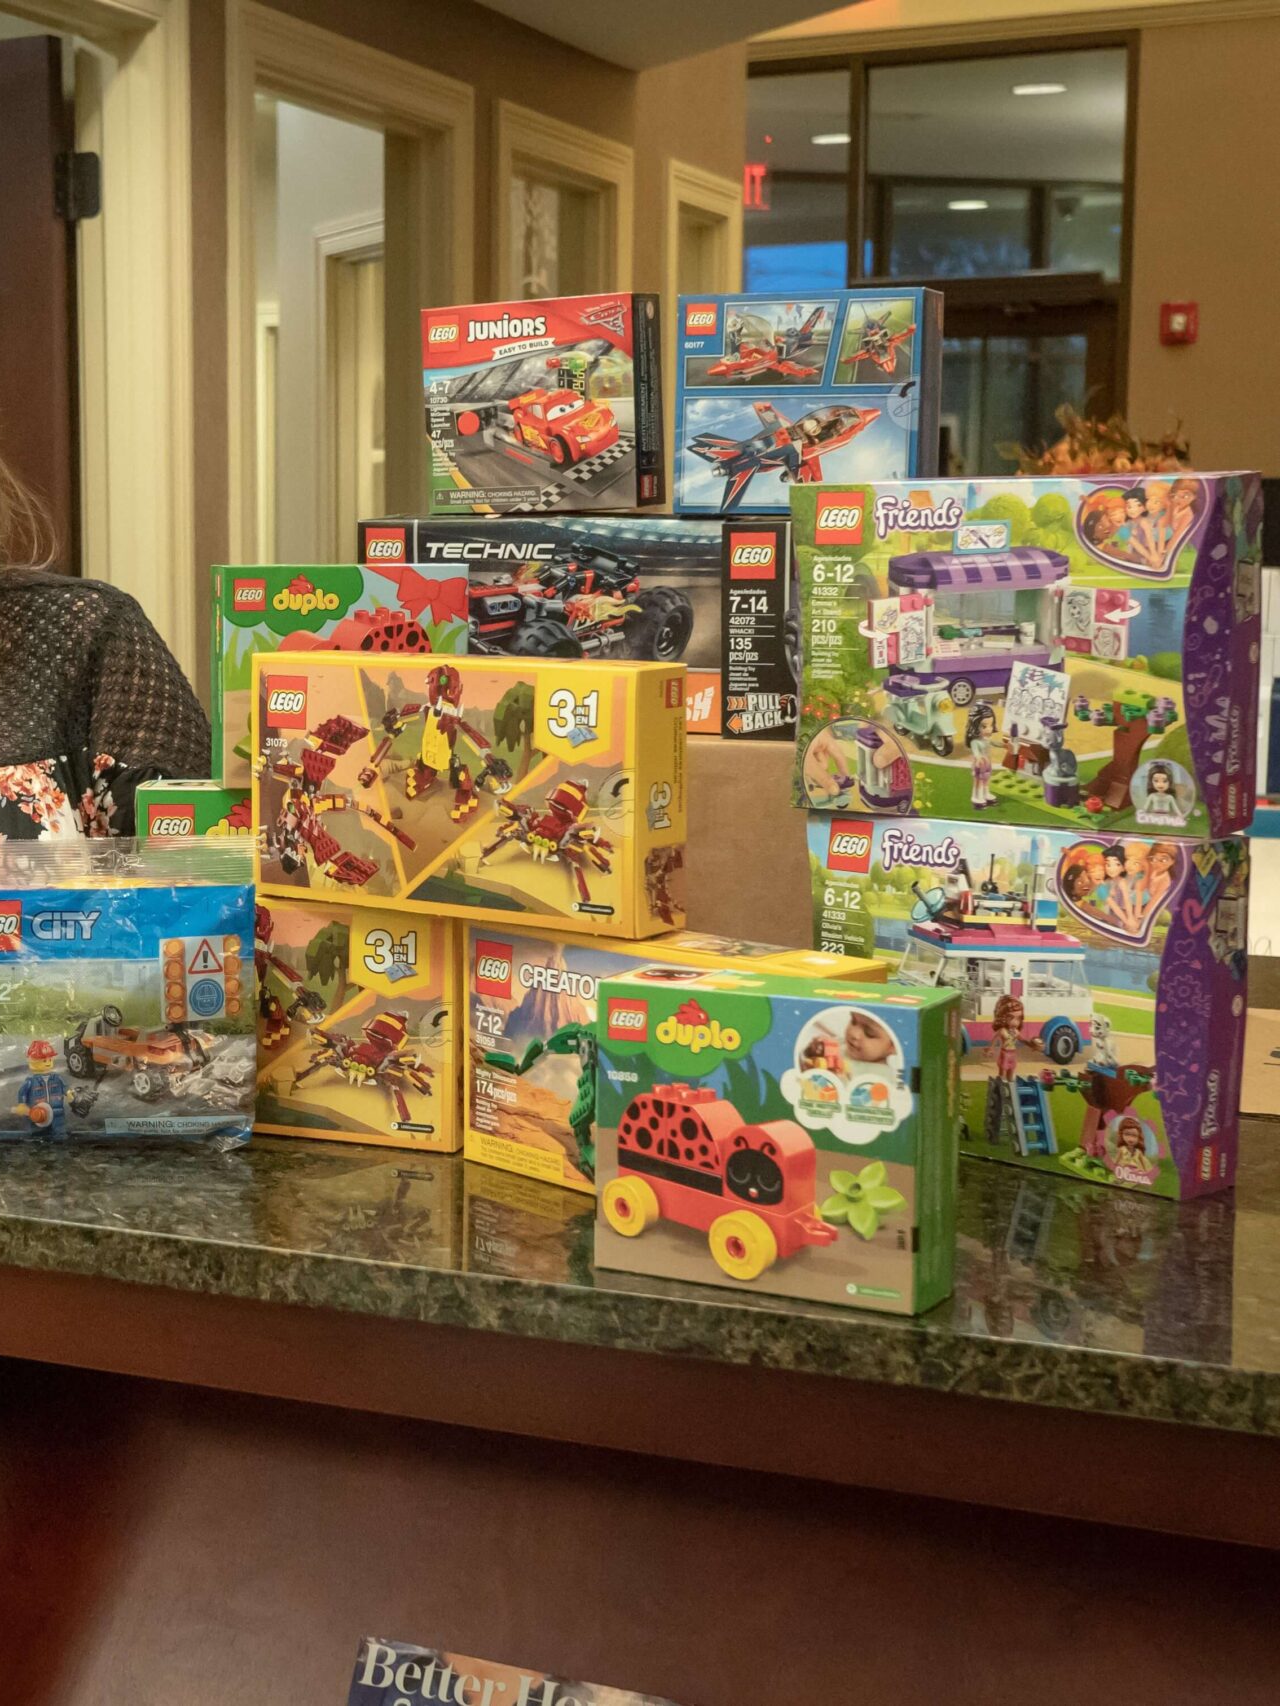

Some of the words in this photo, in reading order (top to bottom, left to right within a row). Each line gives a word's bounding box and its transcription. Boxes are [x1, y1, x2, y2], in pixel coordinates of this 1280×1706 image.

[687, 313, 715, 327] LEGO
[429, 326, 458, 342] LEGO
[499, 347, 516, 356] EASY
[528, 340, 549, 349] BUILD
[429, 381, 451, 394] 4-7
[431, 430, 441, 438] 47
[819, 508, 860, 528] LEGO
[875, 497, 962, 538] Friends
[368, 541, 402, 558] LEGO
[425, 542, 555, 559] TECHNIC
[734, 547, 772, 564] LEGO
[812, 564, 854, 583] 6-12
[811, 587, 838, 596] 41332
[236, 590, 263, 601] LEGO
[272, 588, 340, 615] duplo
[729, 596, 768, 613] 7-14
[729, 617, 756, 625] 42072
[811, 620, 836, 633] 210
[729, 638, 752, 650] 135
[269, 691, 304, 712] LEGO
[747, 693, 781, 711] PULL
[547, 688, 576, 738] 3
[583, 690, 599, 728] 1
[742, 711, 784, 732] BACK
[265, 737, 288, 748] 31073
[152, 818, 191, 836] LEGO
[831, 834, 869, 857] LEGO
[882, 829, 960, 871] Friends
[824, 888, 861, 909] 6-12
[31, 911, 101, 940] CITY
[822, 912, 846, 921] 41333
[363, 928, 394, 975] 3
[400, 930, 417, 965] 1
[821, 942, 845, 955] 223
[394, 954, 407, 962] EN
[478, 957, 509, 981] LEGO
[476, 1011, 503, 1035] 7-12
[611, 1011, 645, 1028] LEGO
[655, 1015, 741, 1053] duplo
[475, 1080, 493, 1096] 174
[357, 1642, 508, 1706] Better
